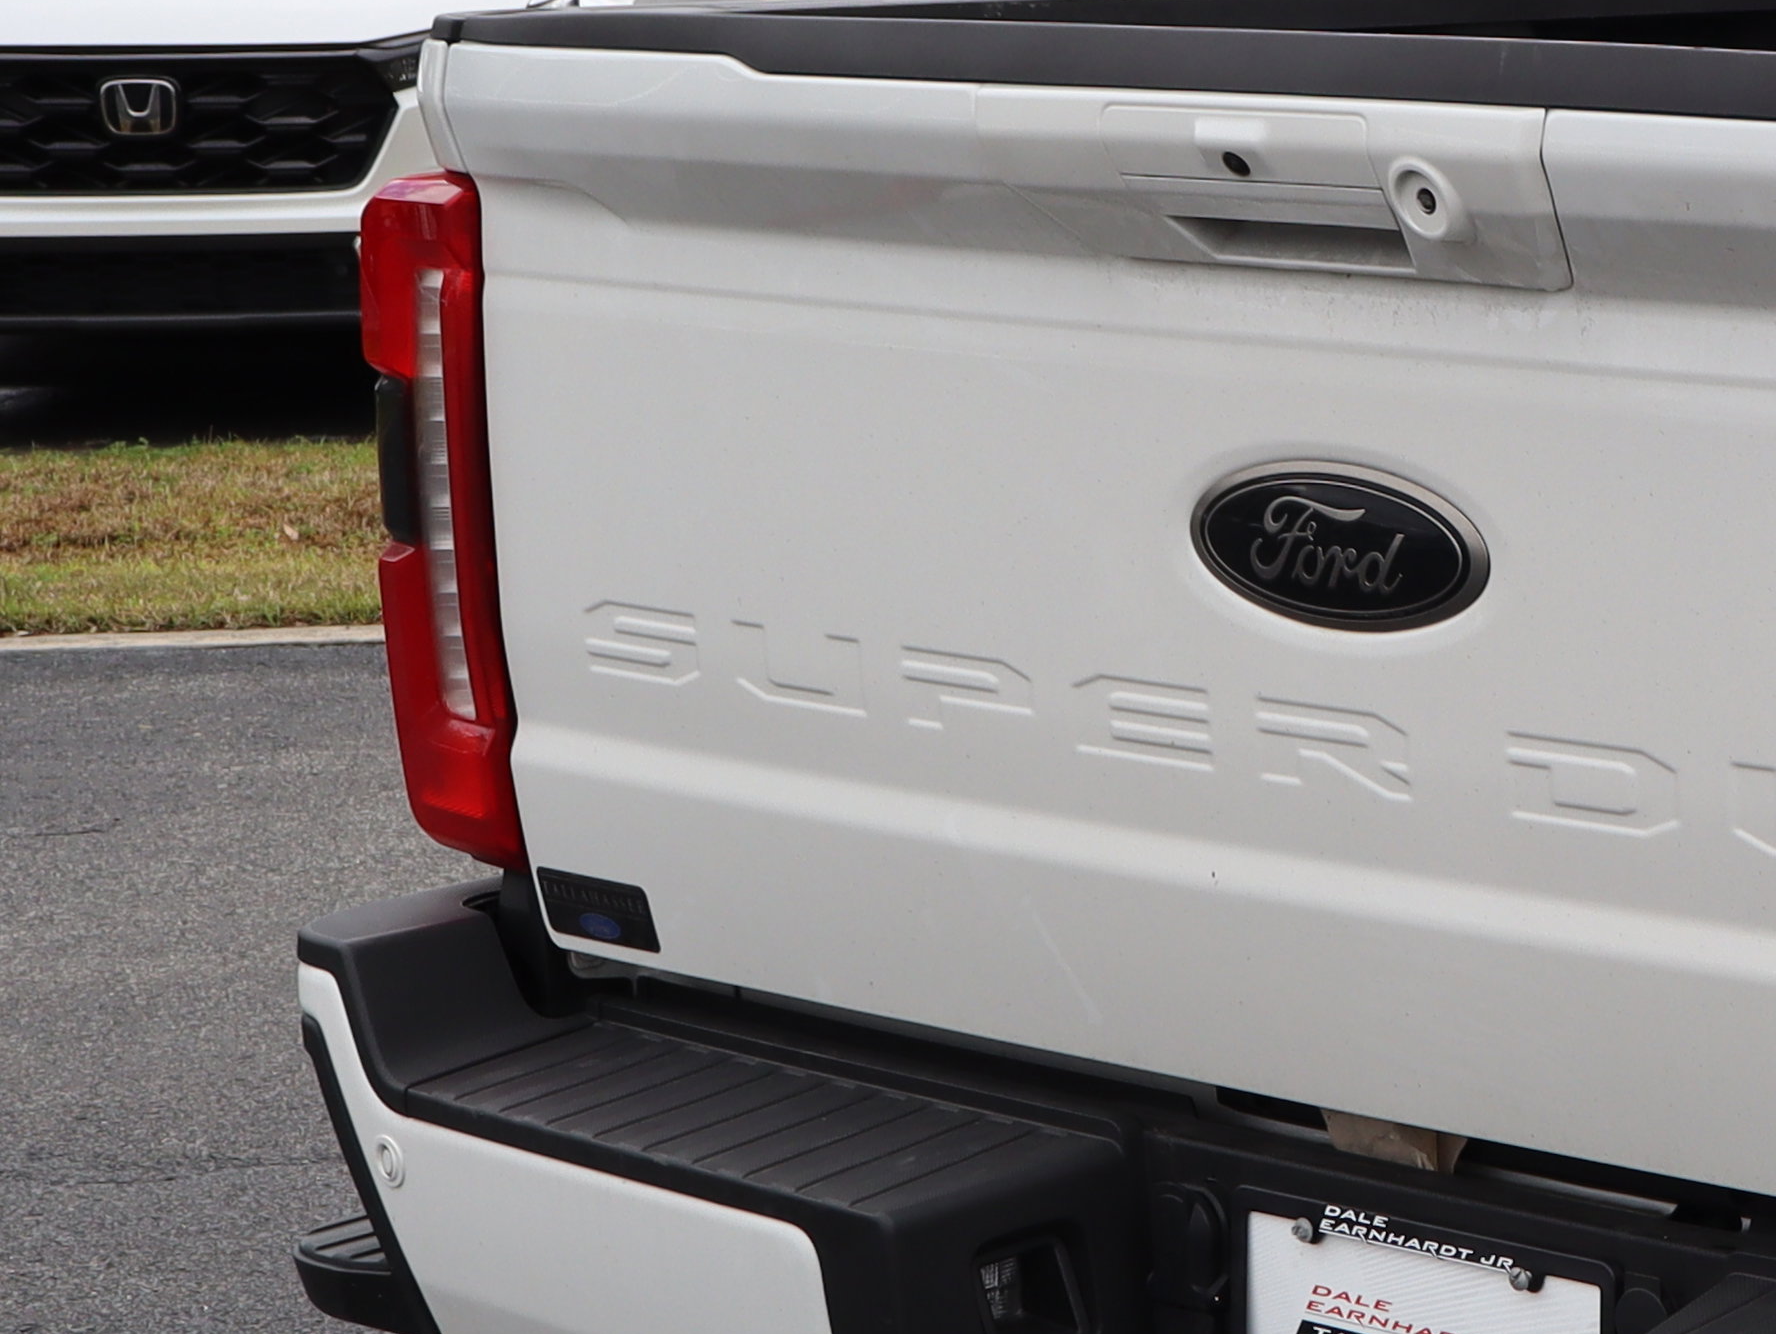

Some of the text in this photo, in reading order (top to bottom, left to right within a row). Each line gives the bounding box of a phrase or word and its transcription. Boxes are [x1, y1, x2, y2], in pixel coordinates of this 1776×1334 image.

[1249, 494, 1407, 594] Ford
[584, 598, 1414, 802] SUPER
[1323, 1204, 1390, 1228] DALE
[1319, 1219, 1515, 1273] EARNHARDT JR
[1311, 1284, 1394, 1313] DALE
